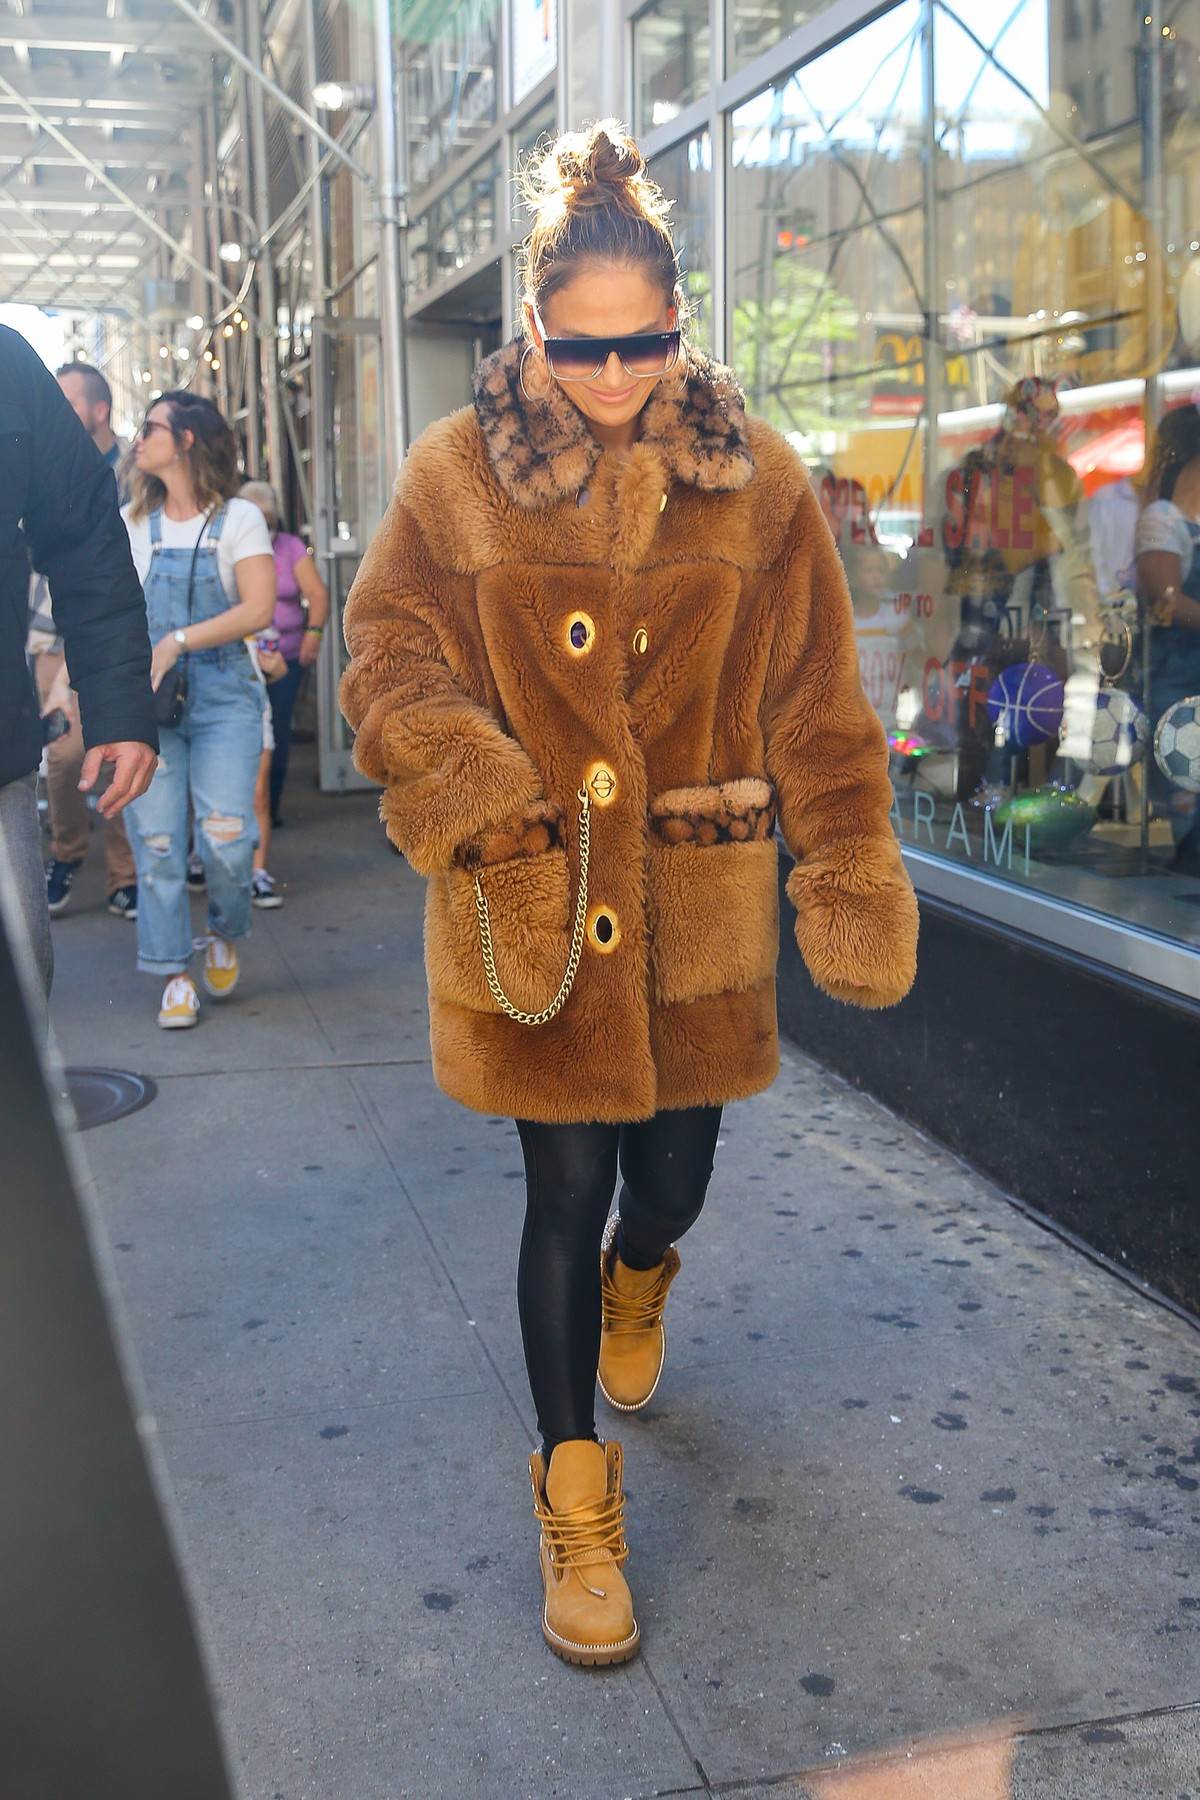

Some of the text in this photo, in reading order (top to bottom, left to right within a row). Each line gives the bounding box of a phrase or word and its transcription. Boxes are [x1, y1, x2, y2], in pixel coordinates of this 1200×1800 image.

[946, 467, 1034, 549] SALE
[894, 592, 933, 618] UP TO
[923, 656, 989, 729] OFF
